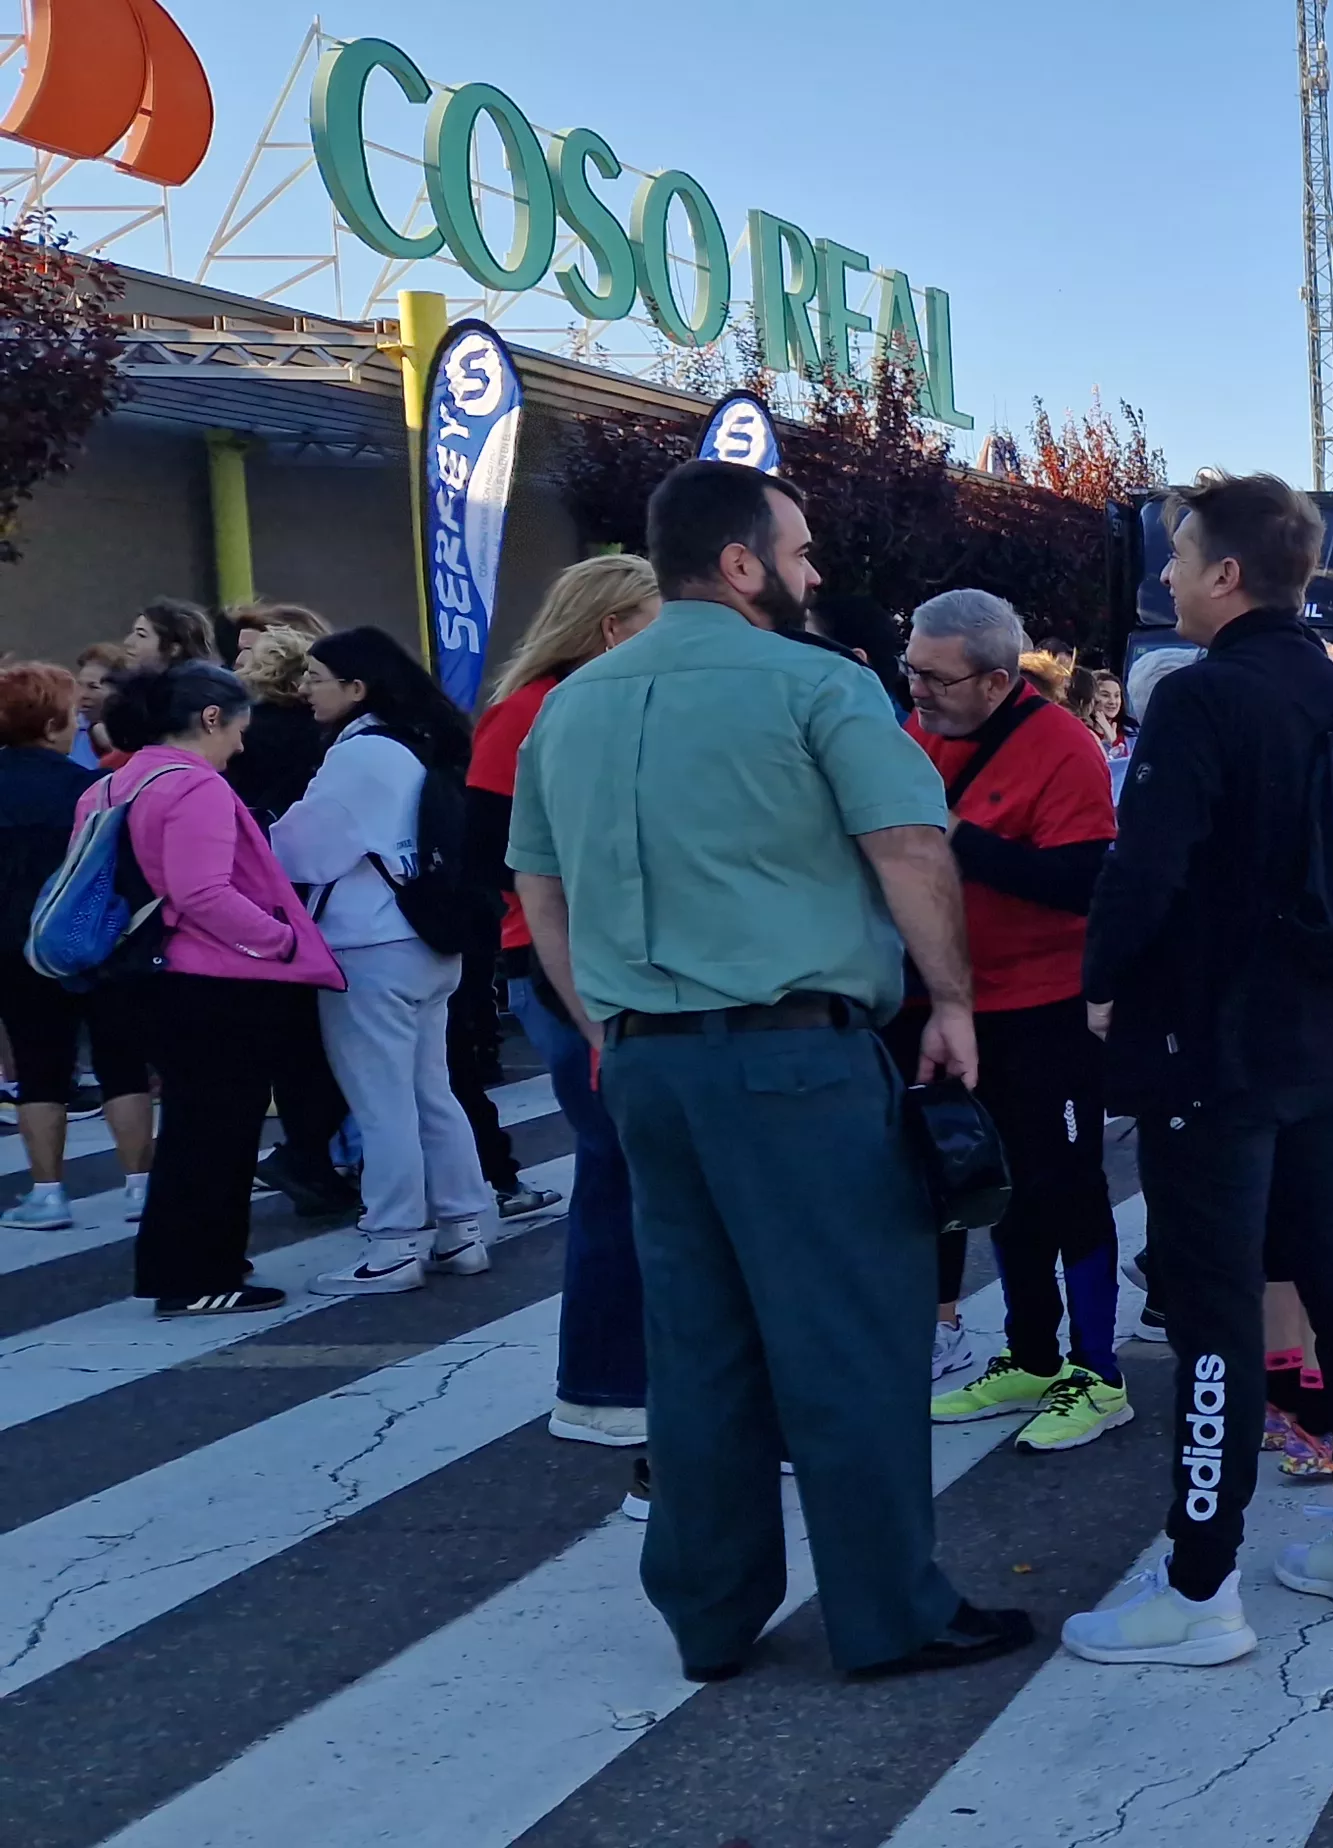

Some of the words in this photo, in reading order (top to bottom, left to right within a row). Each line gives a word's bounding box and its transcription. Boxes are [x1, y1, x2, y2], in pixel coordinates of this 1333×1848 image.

[310, 37, 731, 347] COSO
[748, 209, 974, 430] REAL
[1182, 1354, 1225, 1521] adidas
